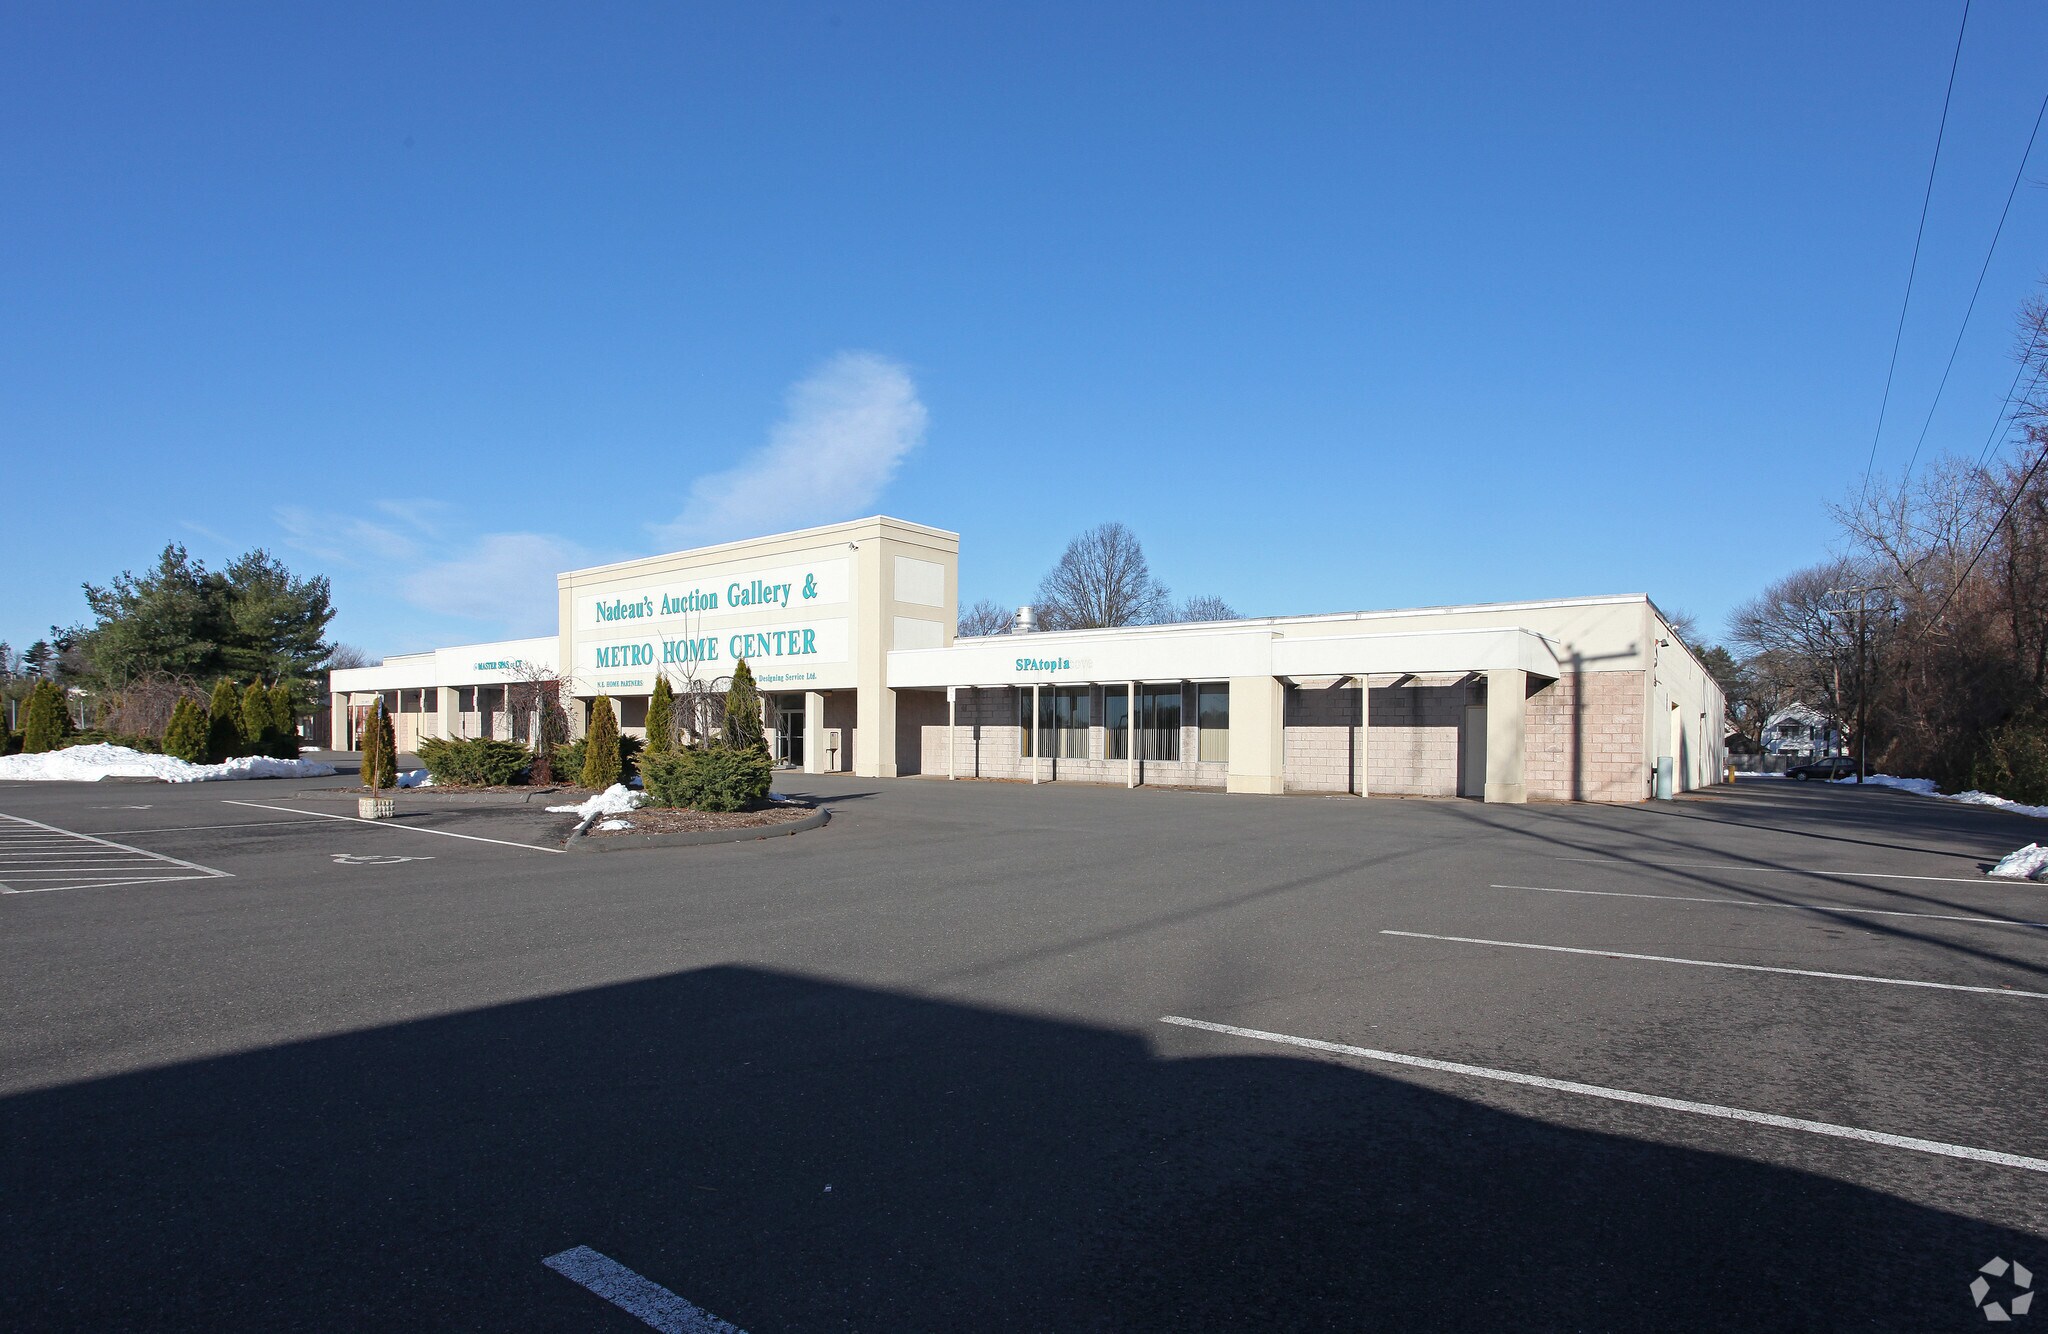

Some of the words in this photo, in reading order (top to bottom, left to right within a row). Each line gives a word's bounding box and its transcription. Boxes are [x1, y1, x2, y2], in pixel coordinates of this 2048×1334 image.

[596, 595, 654, 622] Nadeau's
[660, 588, 718, 615] Auction
[727, 579, 792, 608] Gallery
[802, 573, 818, 599] &
[596, 643, 653, 668] METRO
[662, 637, 719, 664] HOME
[729, 628, 817, 659] CENTER
[477, 662, 497, 670] MASTER
[1015, 657, 1070, 673] SPAtopia
[758, 674, 784, 682] Designing
[785, 673, 804, 681] Service
